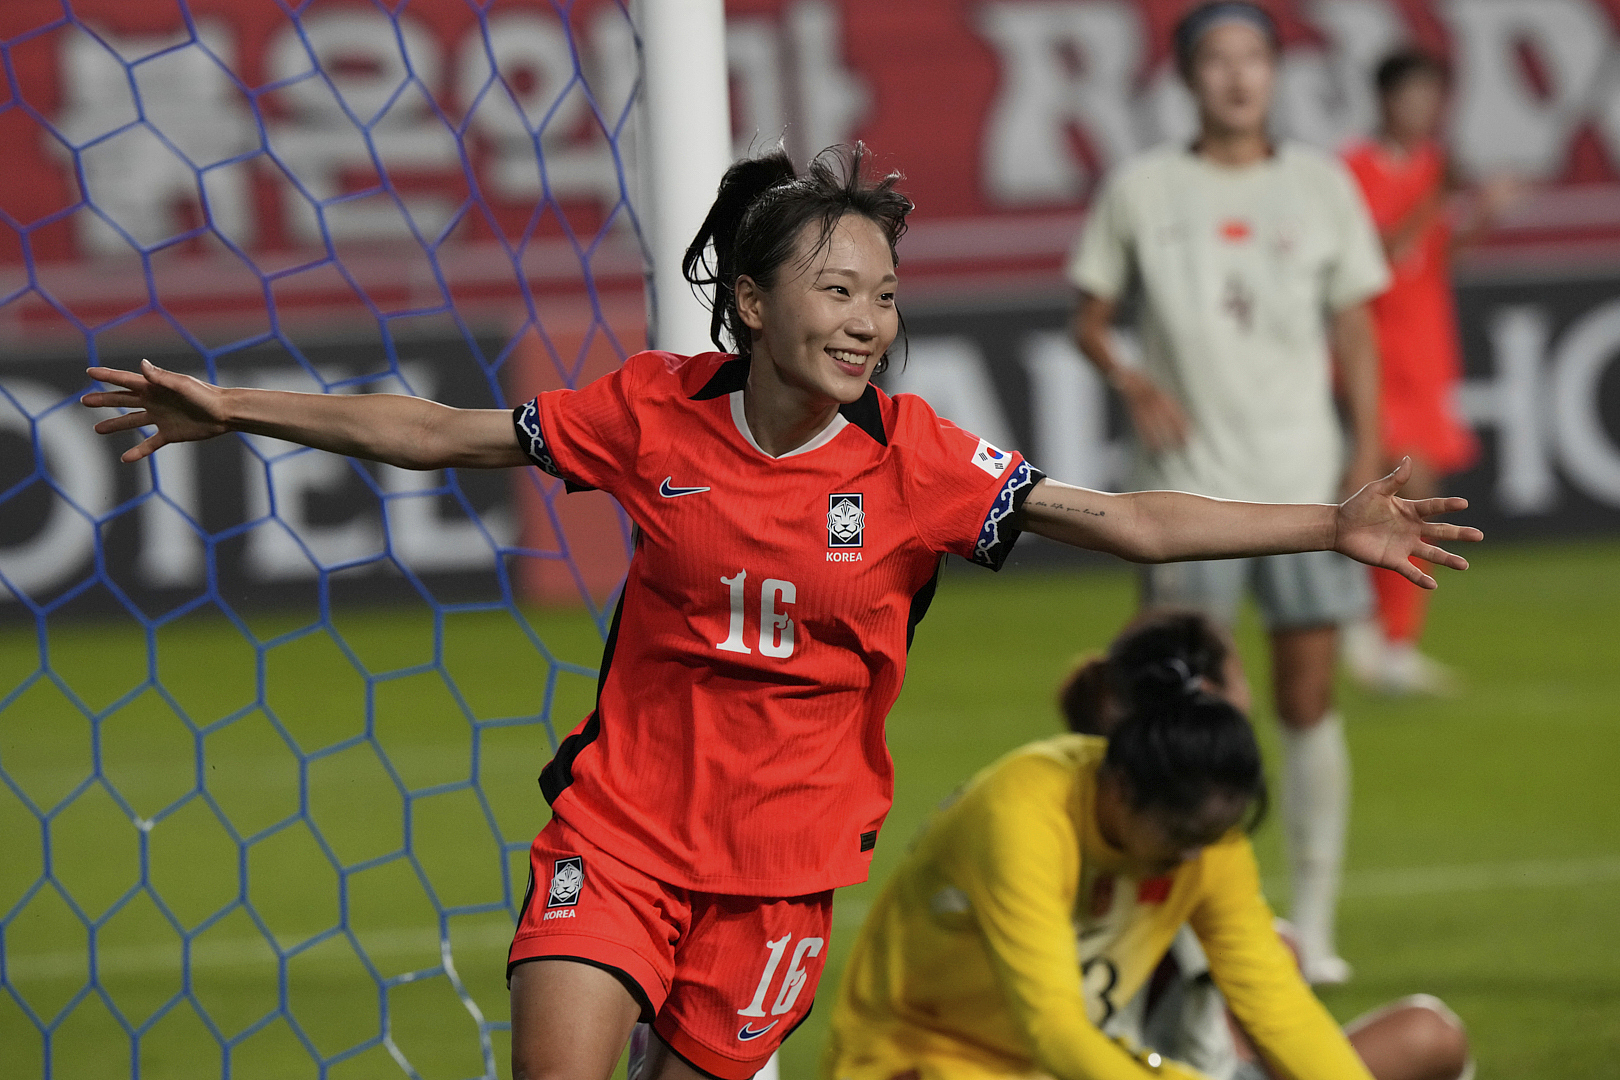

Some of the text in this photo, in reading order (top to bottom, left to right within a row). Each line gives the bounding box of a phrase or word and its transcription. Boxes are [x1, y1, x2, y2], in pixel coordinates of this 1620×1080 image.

[826, 552, 862, 562] KOREA
[716, 568, 796, 658] 16
[543, 909, 576, 920] KOREA
[737, 932, 824, 1017] 16
